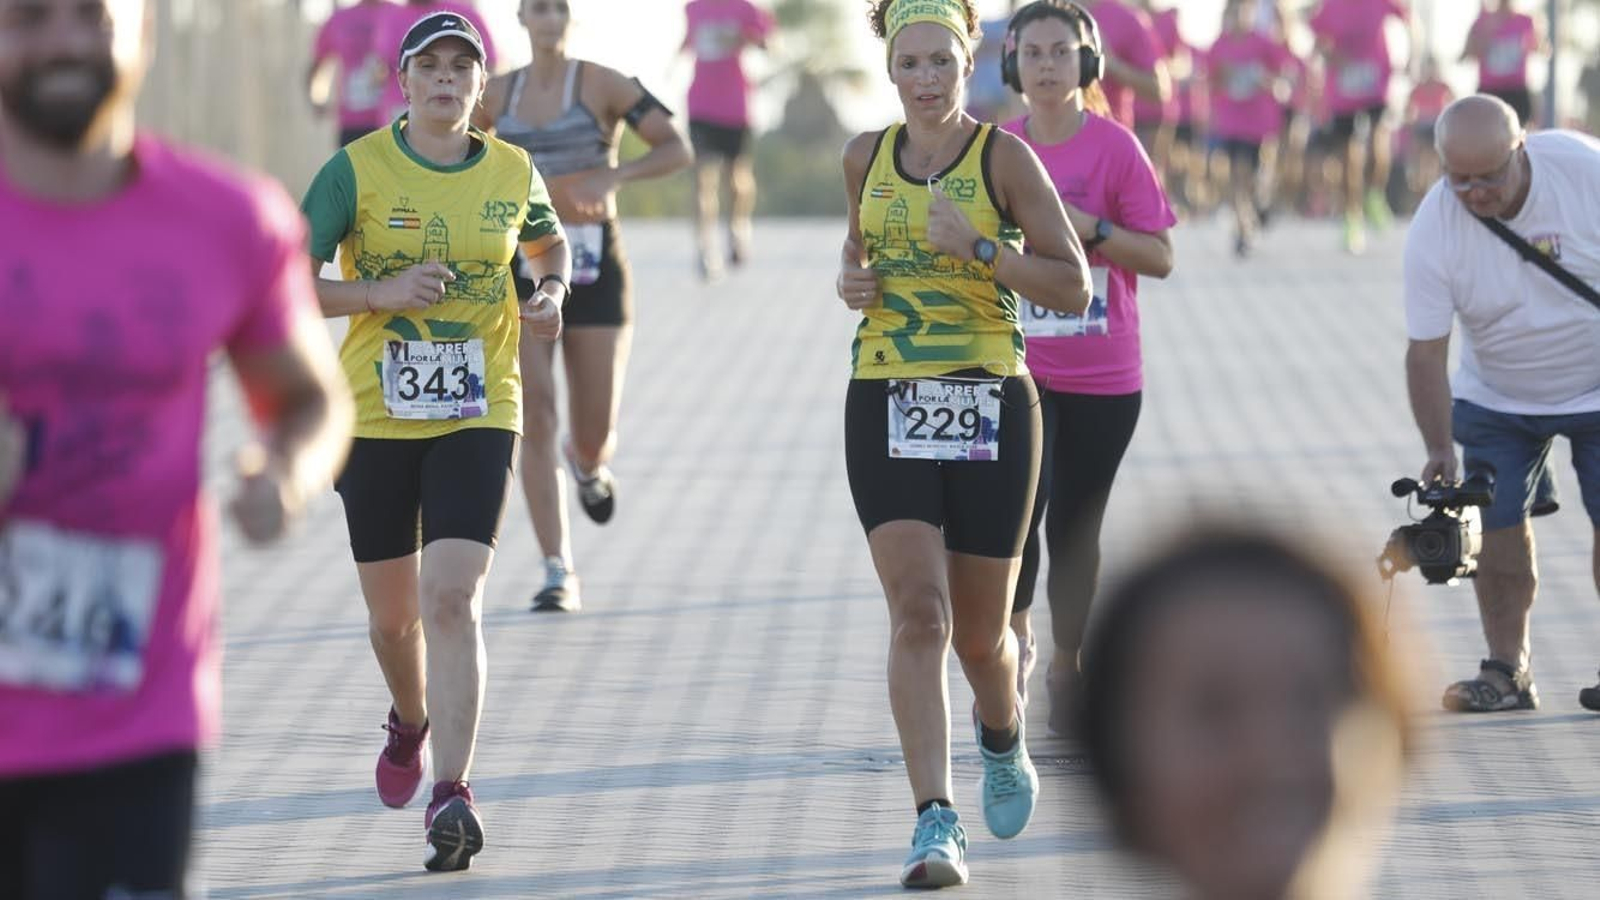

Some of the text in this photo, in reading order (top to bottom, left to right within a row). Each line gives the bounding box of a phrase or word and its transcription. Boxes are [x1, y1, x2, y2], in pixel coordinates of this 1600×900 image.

[410, 354, 428, 362] POR
[429, 354, 441, 362] LA
[399, 365, 470, 402] 343
[938, 395, 950, 403] LA
[905, 406, 981, 441] 229
